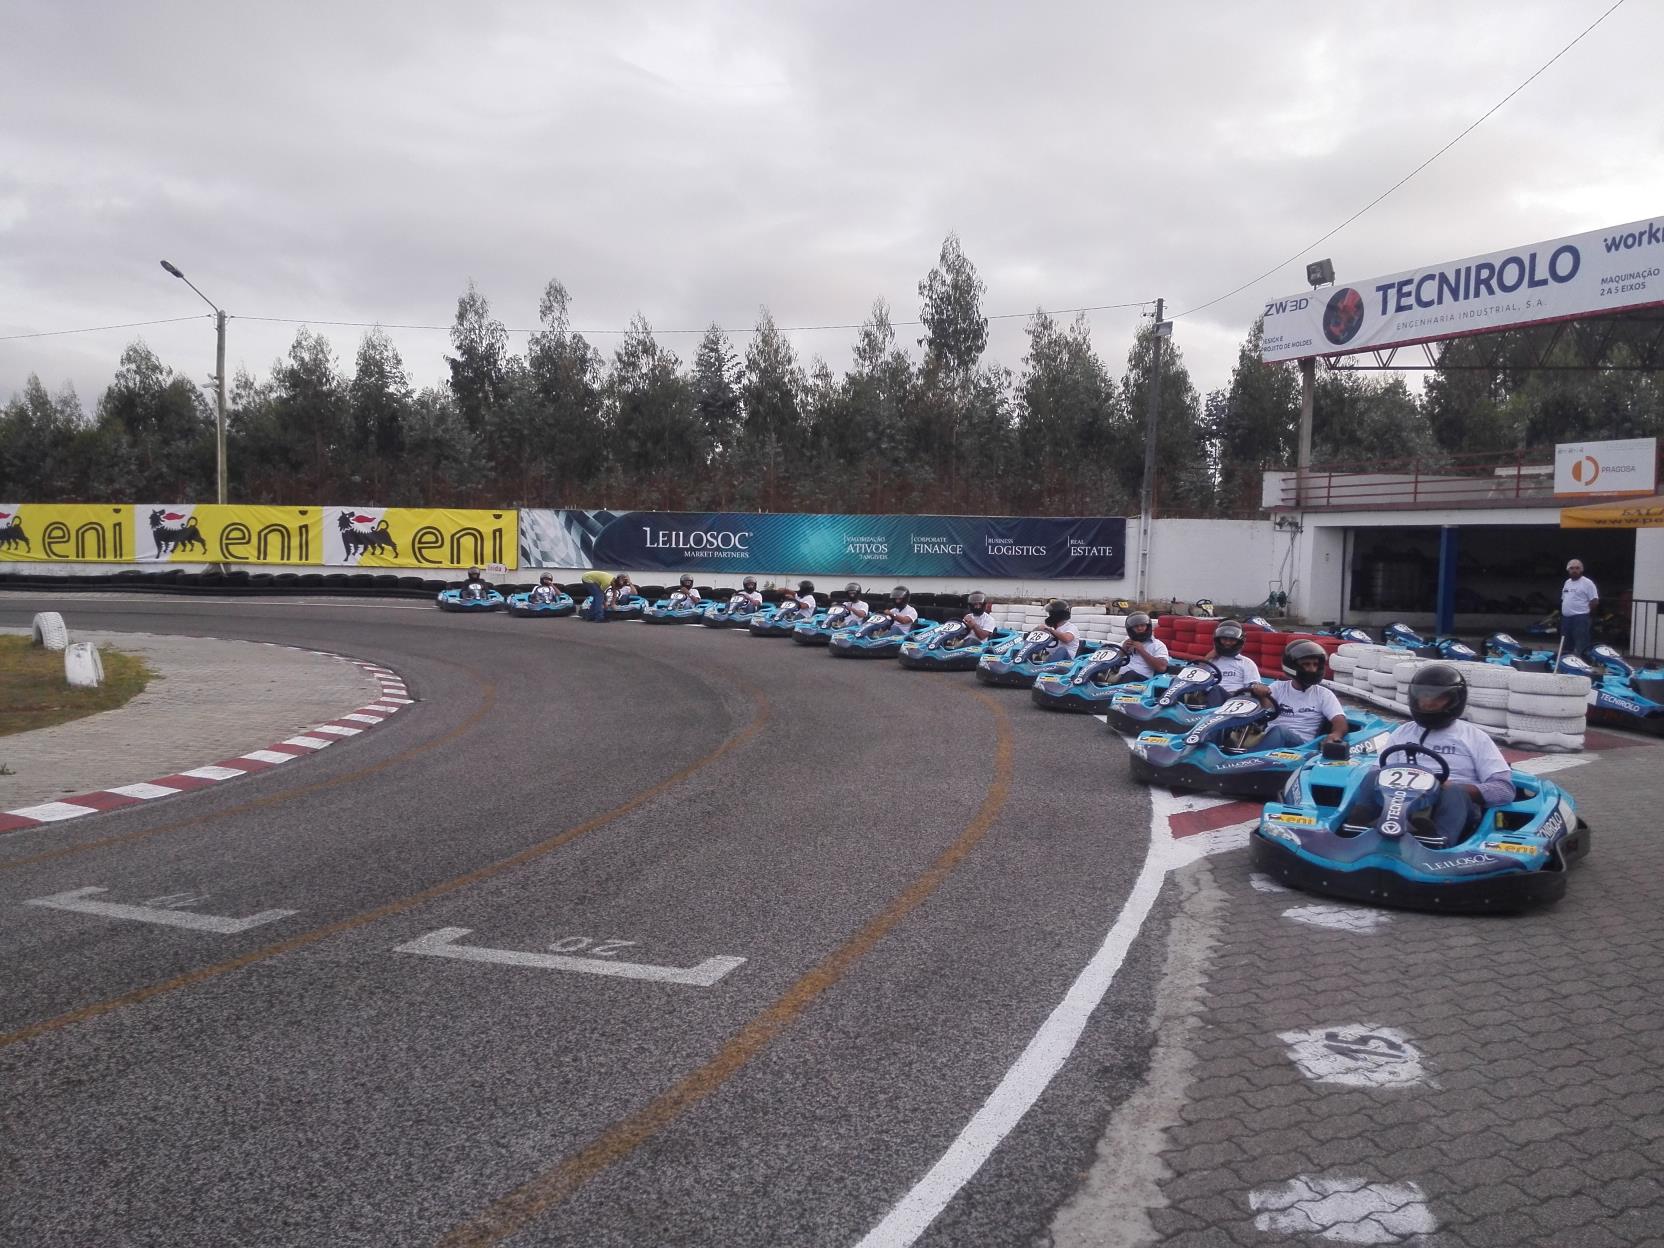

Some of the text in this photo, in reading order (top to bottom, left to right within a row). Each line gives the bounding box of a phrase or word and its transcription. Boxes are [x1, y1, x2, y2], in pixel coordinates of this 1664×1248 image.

[1375, 245, 1581, 316] TECNIROLO
[1600, 268, 1660, 285] MAQUINAÇÃO
[1600, 288, 1605, 296] 2
[1621, 281, 1646, 293] EIXOS
[1396, 314, 1455, 331] ENGENHARIA
[1291, 338, 1313, 348] MOLDES
[42, 508, 123, 559] eni
[220, 510, 309, 561] eni
[411, 513, 503, 565] eni
[643, 527, 750, 549] LEILOSOC
[684, 550, 749, 558] MARKET PARTNERS
[846, 543, 888, 553] ATIVOS
[914, 544, 963, 554] FINANCE
[988, 545, 1047, 556] LOGISTICS
[1071, 546, 1113, 556] ESTATE
[1030, 631, 1043, 641] 26
[1186, 669, 1197, 678] 8
[1224, 701, 1244, 713] 13
[1433, 744, 1456, 755] eni
[1388, 771, 1420, 788] 27
[1424, 852, 1496, 871] LEILOSOC
